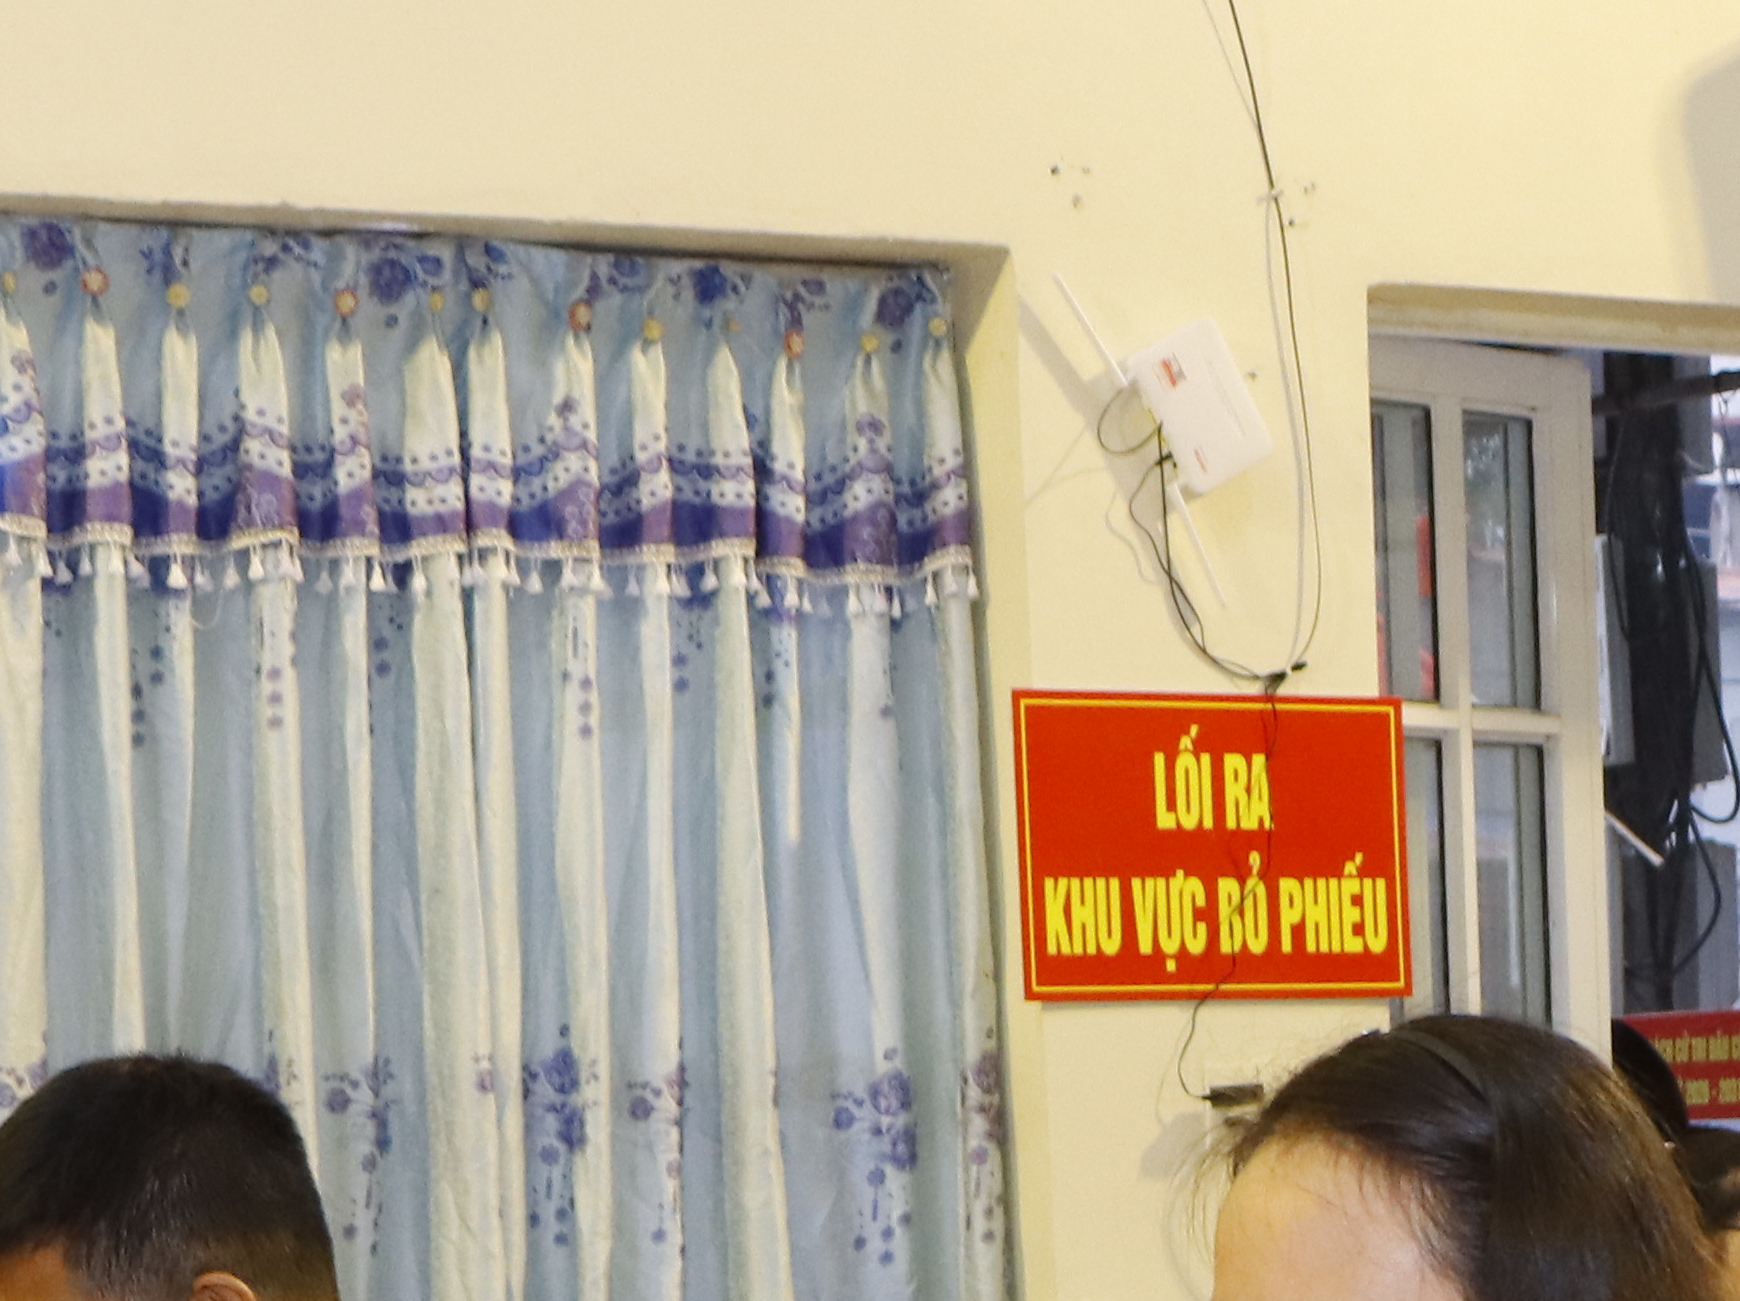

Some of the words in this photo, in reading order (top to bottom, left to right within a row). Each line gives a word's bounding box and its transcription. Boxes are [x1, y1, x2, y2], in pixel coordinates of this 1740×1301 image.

[1152, 725, 1213, 832] LỐI
[1225, 751, 1273, 832] RA
[1043, 875, 1122, 957] KHU
[1130, 866, 1206, 973] VỰC
[1217, 851, 1269, 956] BỎ
[1278, 850, 1389, 955] PHIẾU
